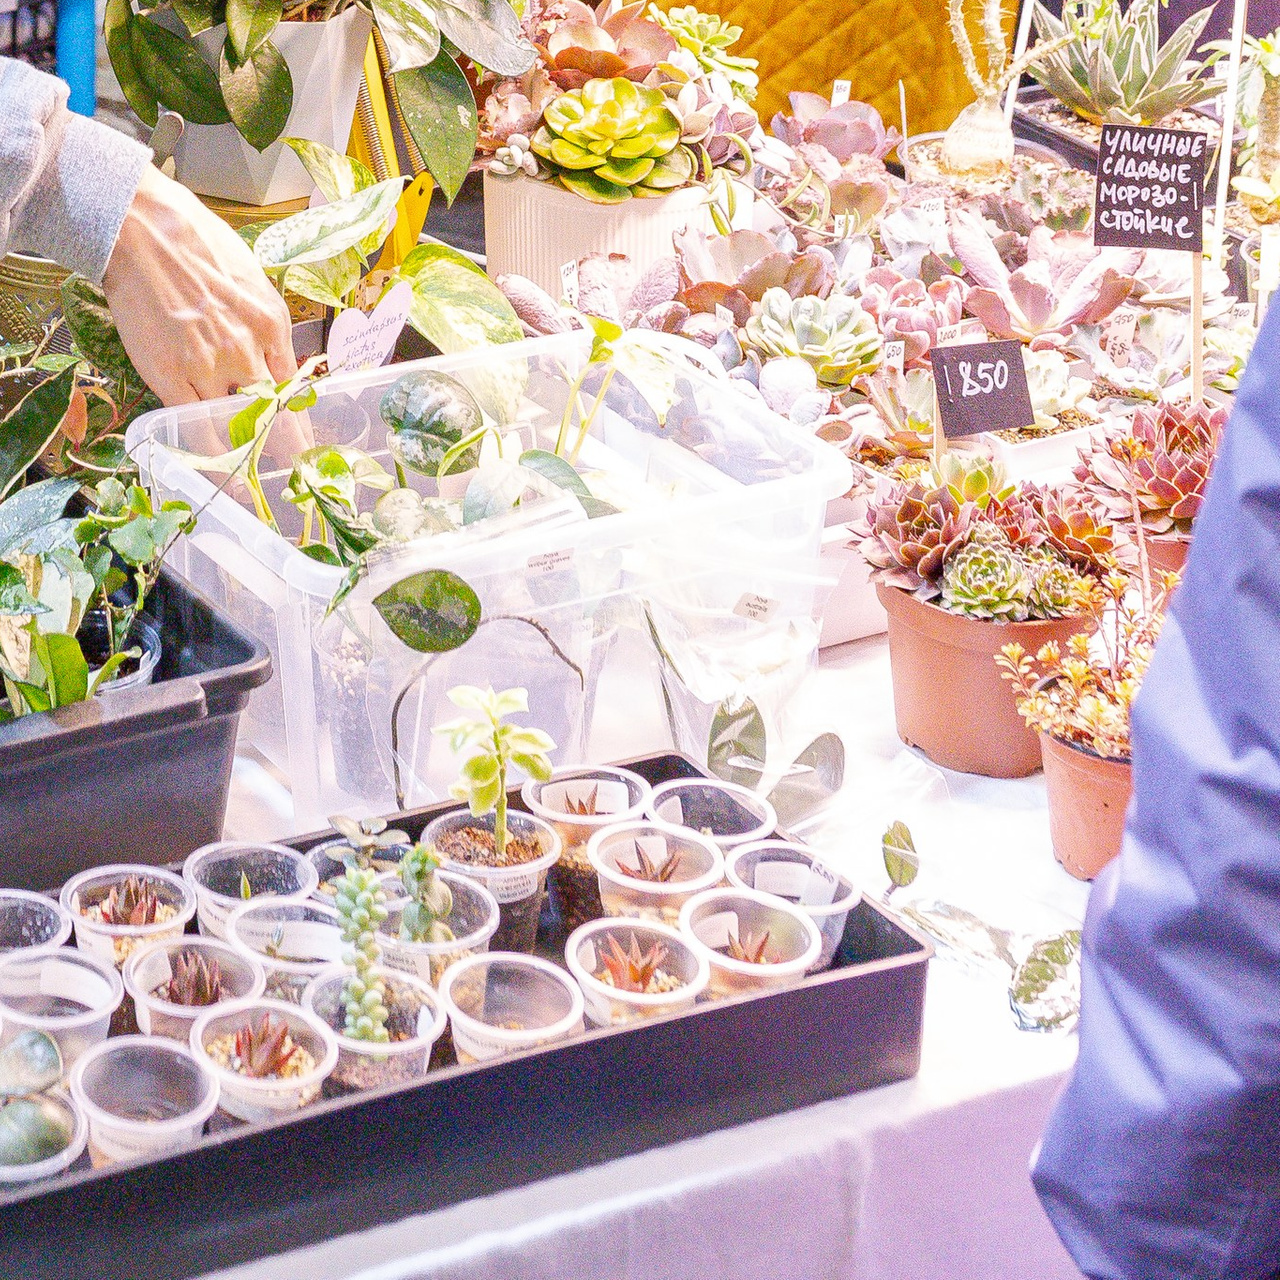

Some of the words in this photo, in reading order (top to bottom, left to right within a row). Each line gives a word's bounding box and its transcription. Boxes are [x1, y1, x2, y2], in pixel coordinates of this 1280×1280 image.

[1105, 129, 1206, 157] УЛИЧНЫЕ
[1103, 155, 1191, 184] САДОВЫЕ
[886, 343, 902, 360] 650
